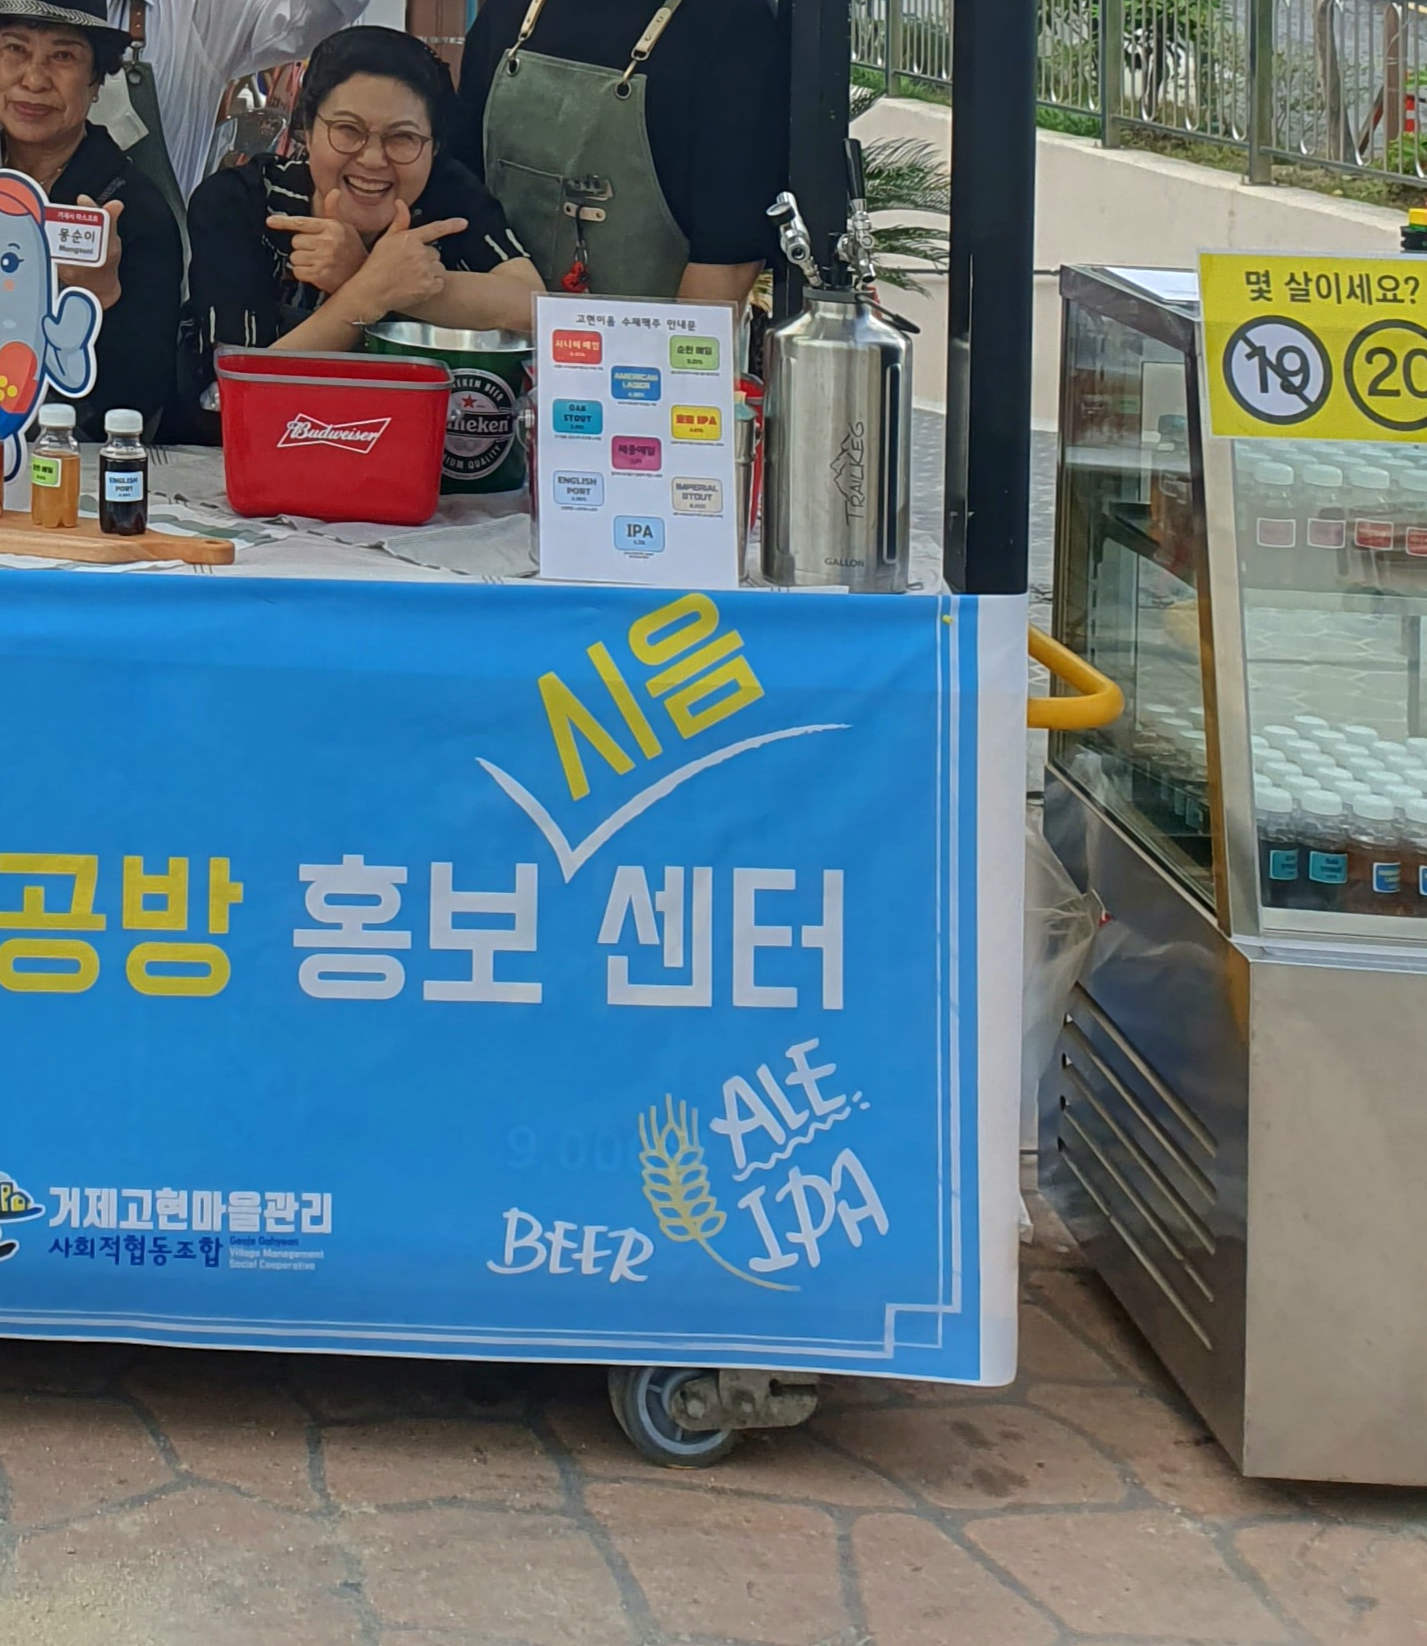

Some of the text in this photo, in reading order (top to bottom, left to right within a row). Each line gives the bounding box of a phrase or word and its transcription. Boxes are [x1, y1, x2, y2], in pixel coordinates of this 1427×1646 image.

[58, 228, 95, 244] 몽순이
[1244, 270, 1420, 306] 몇 살이세요?
[576, 313, 616, 328] 고현이음
[563, 414, 593, 423] STOUT
[286, 419, 380, 443] Budweiser
[557, 476, 597, 486] ENGLISH
[844, 421, 867, 527] TRAILKEG
[566, 486, 591, 496] PORT
[675, 483, 719, 494] IMPERIAL
[626, 524, 654, 539] IPA
[824, 556, 865, 568] GALLON
[537, 592, 766, 802] 시음
[293, 854, 543, 1004] 홍보
[597, 865, 844, 1010] 센터
[709, 1037, 848, 1170] ALE
[47, 1186, 333, 1234] 거제고현마을관리
[48, 1234, 224, 1268] 사회적협동조합
[486, 1207, 655, 1283] BEER
